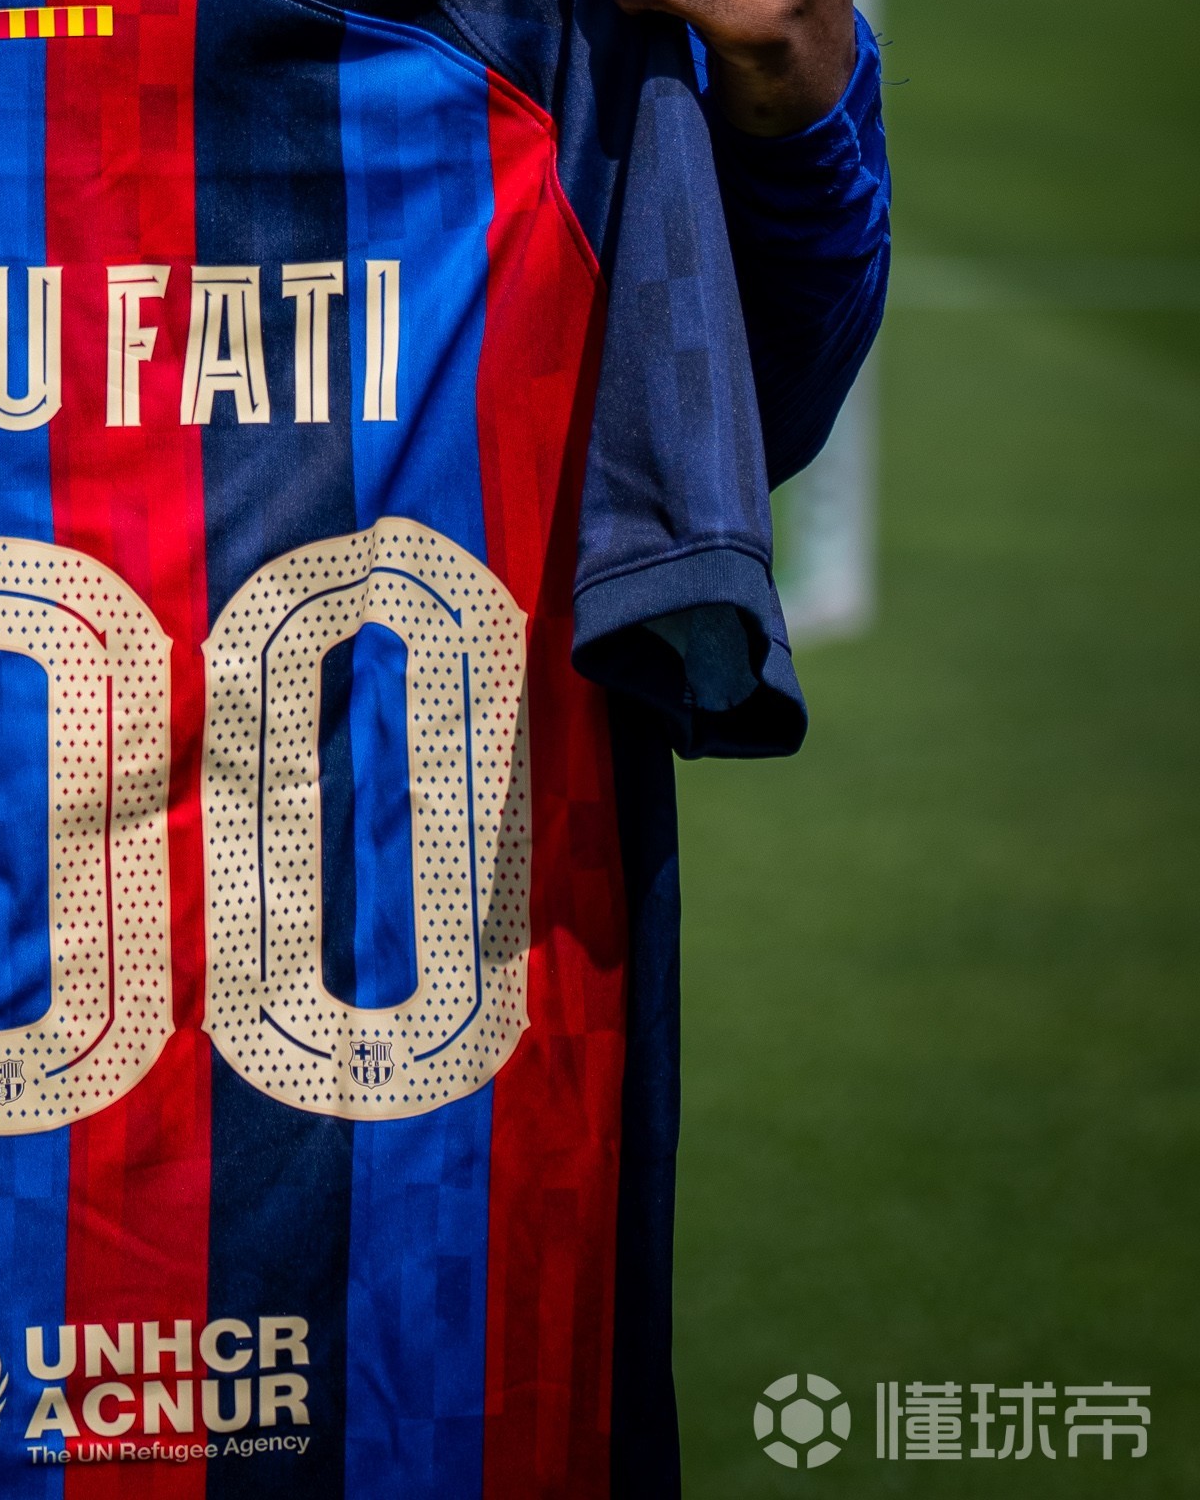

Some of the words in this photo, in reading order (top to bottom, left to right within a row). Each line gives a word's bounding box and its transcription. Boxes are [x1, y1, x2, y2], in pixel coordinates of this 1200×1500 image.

[104, 259, 401, 427] FATI
[25, 1315, 310, 1381] UNHCR
[24, 1372, 311, 1439] ACNUR
[27, 1445, 71, 1465] The
[77, 1442, 113, 1463] UN
[119, 1440, 218, 1463] Refugee
[223, 1435, 311, 1458] Agency
